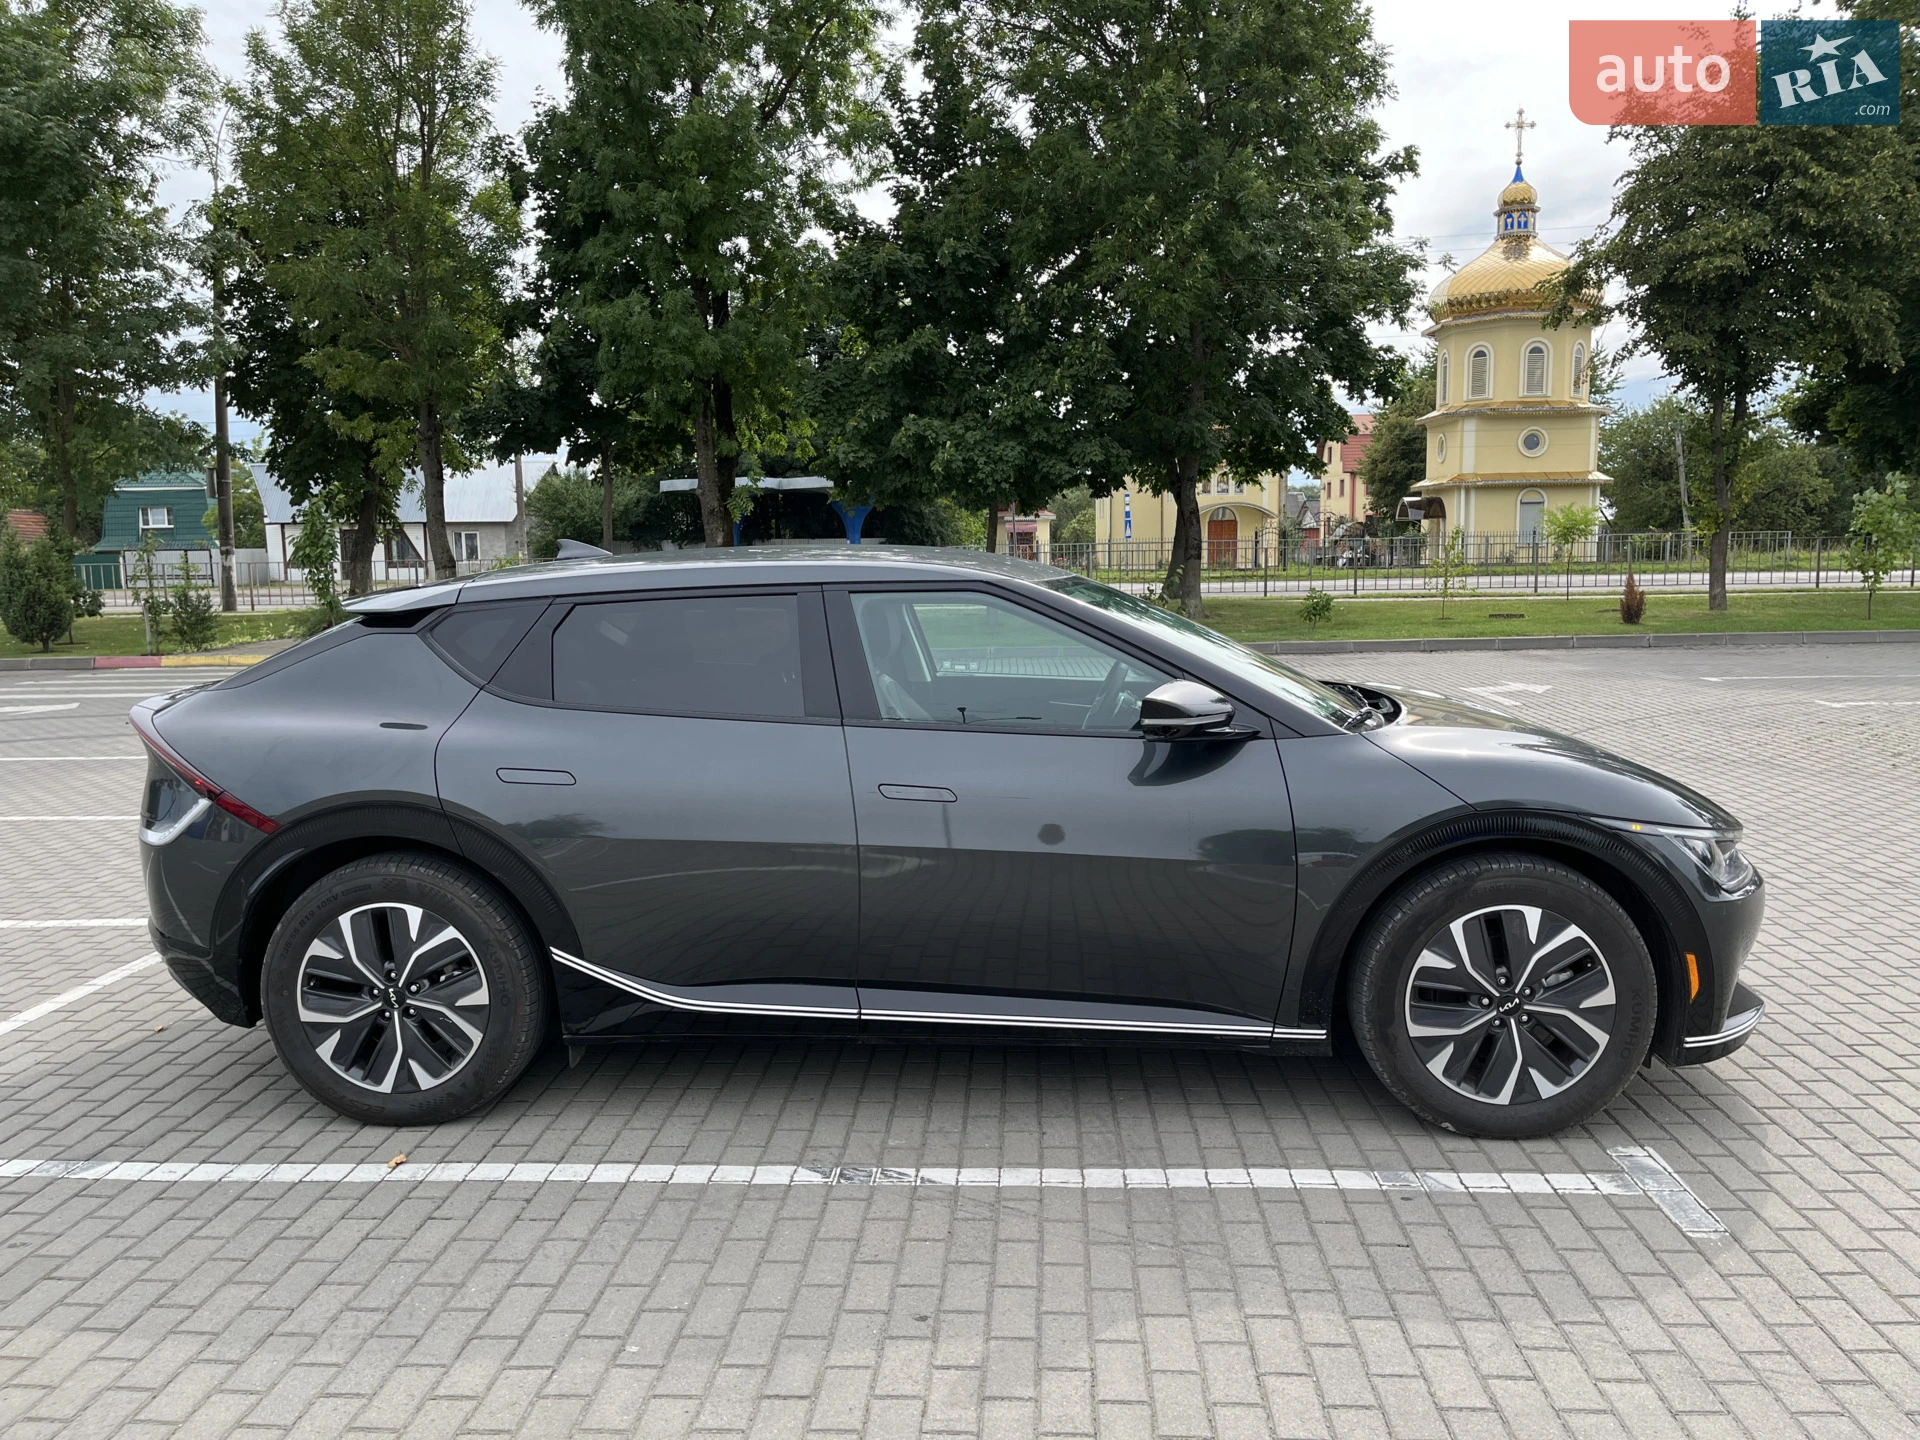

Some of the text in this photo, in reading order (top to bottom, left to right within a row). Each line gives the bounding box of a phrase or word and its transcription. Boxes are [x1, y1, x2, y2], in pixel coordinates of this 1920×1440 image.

[316, 893, 339, 912] 105V
[483, 938, 511, 1009] KUMHO
[1620, 988, 1643, 1061] KUMHO
